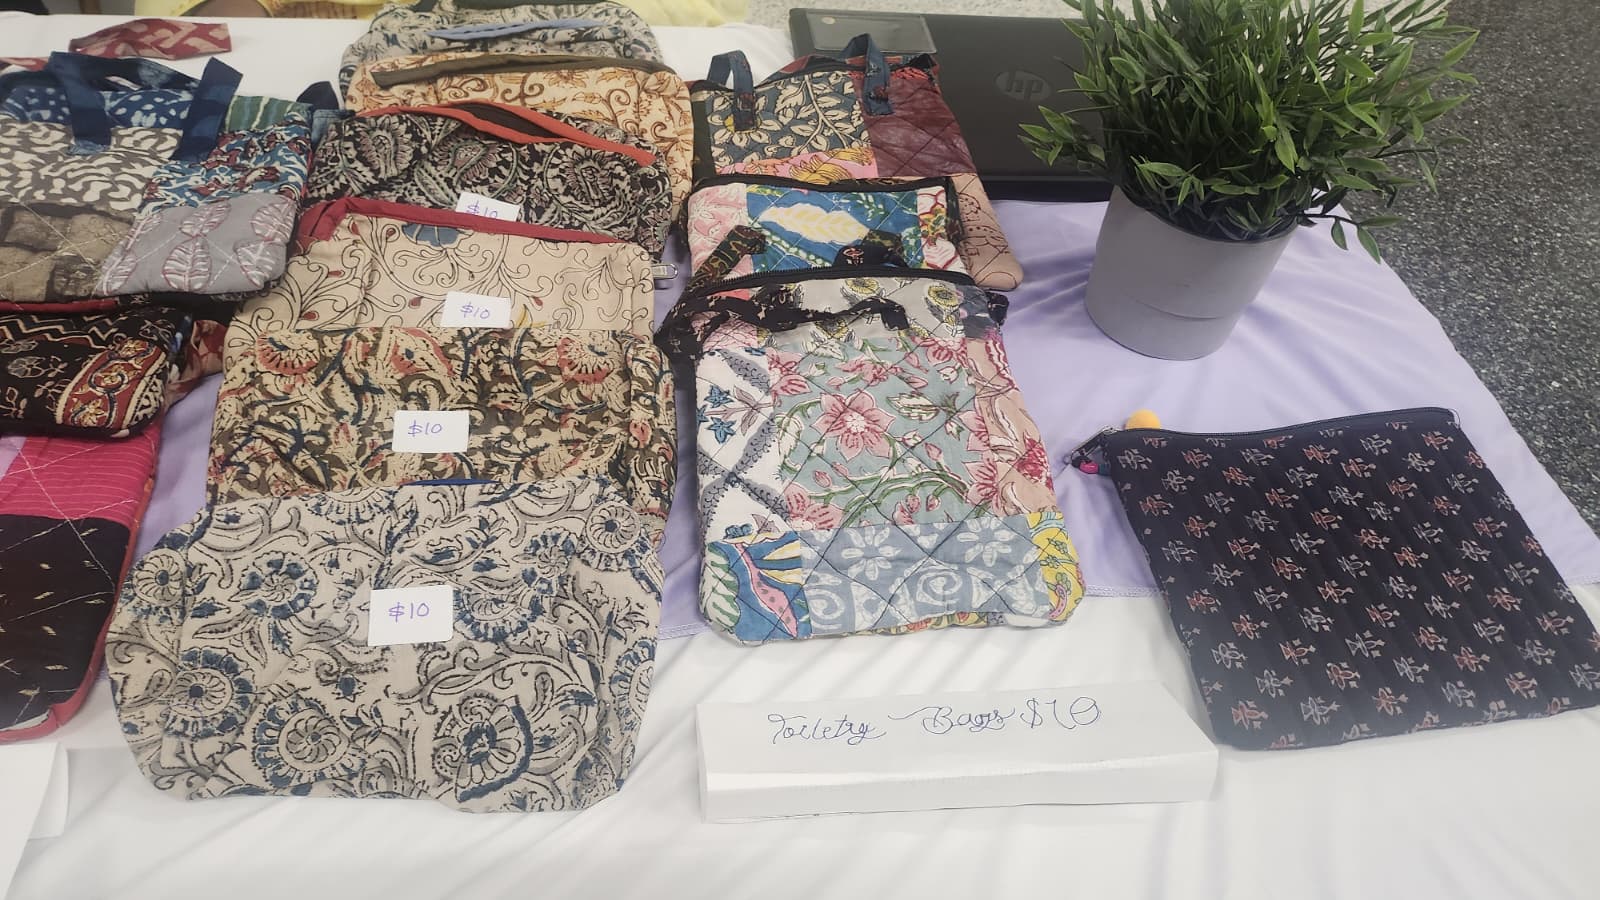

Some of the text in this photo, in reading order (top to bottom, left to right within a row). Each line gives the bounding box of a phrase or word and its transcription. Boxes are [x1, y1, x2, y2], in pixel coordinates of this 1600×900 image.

[1005, 70, 1044, 101] hp
[460, 301, 490, 319] $10
[408, 420, 443, 437] $10
[388, 602, 430, 623] $10
[768, 696, 1100, 745] Toiletry Bags $10
